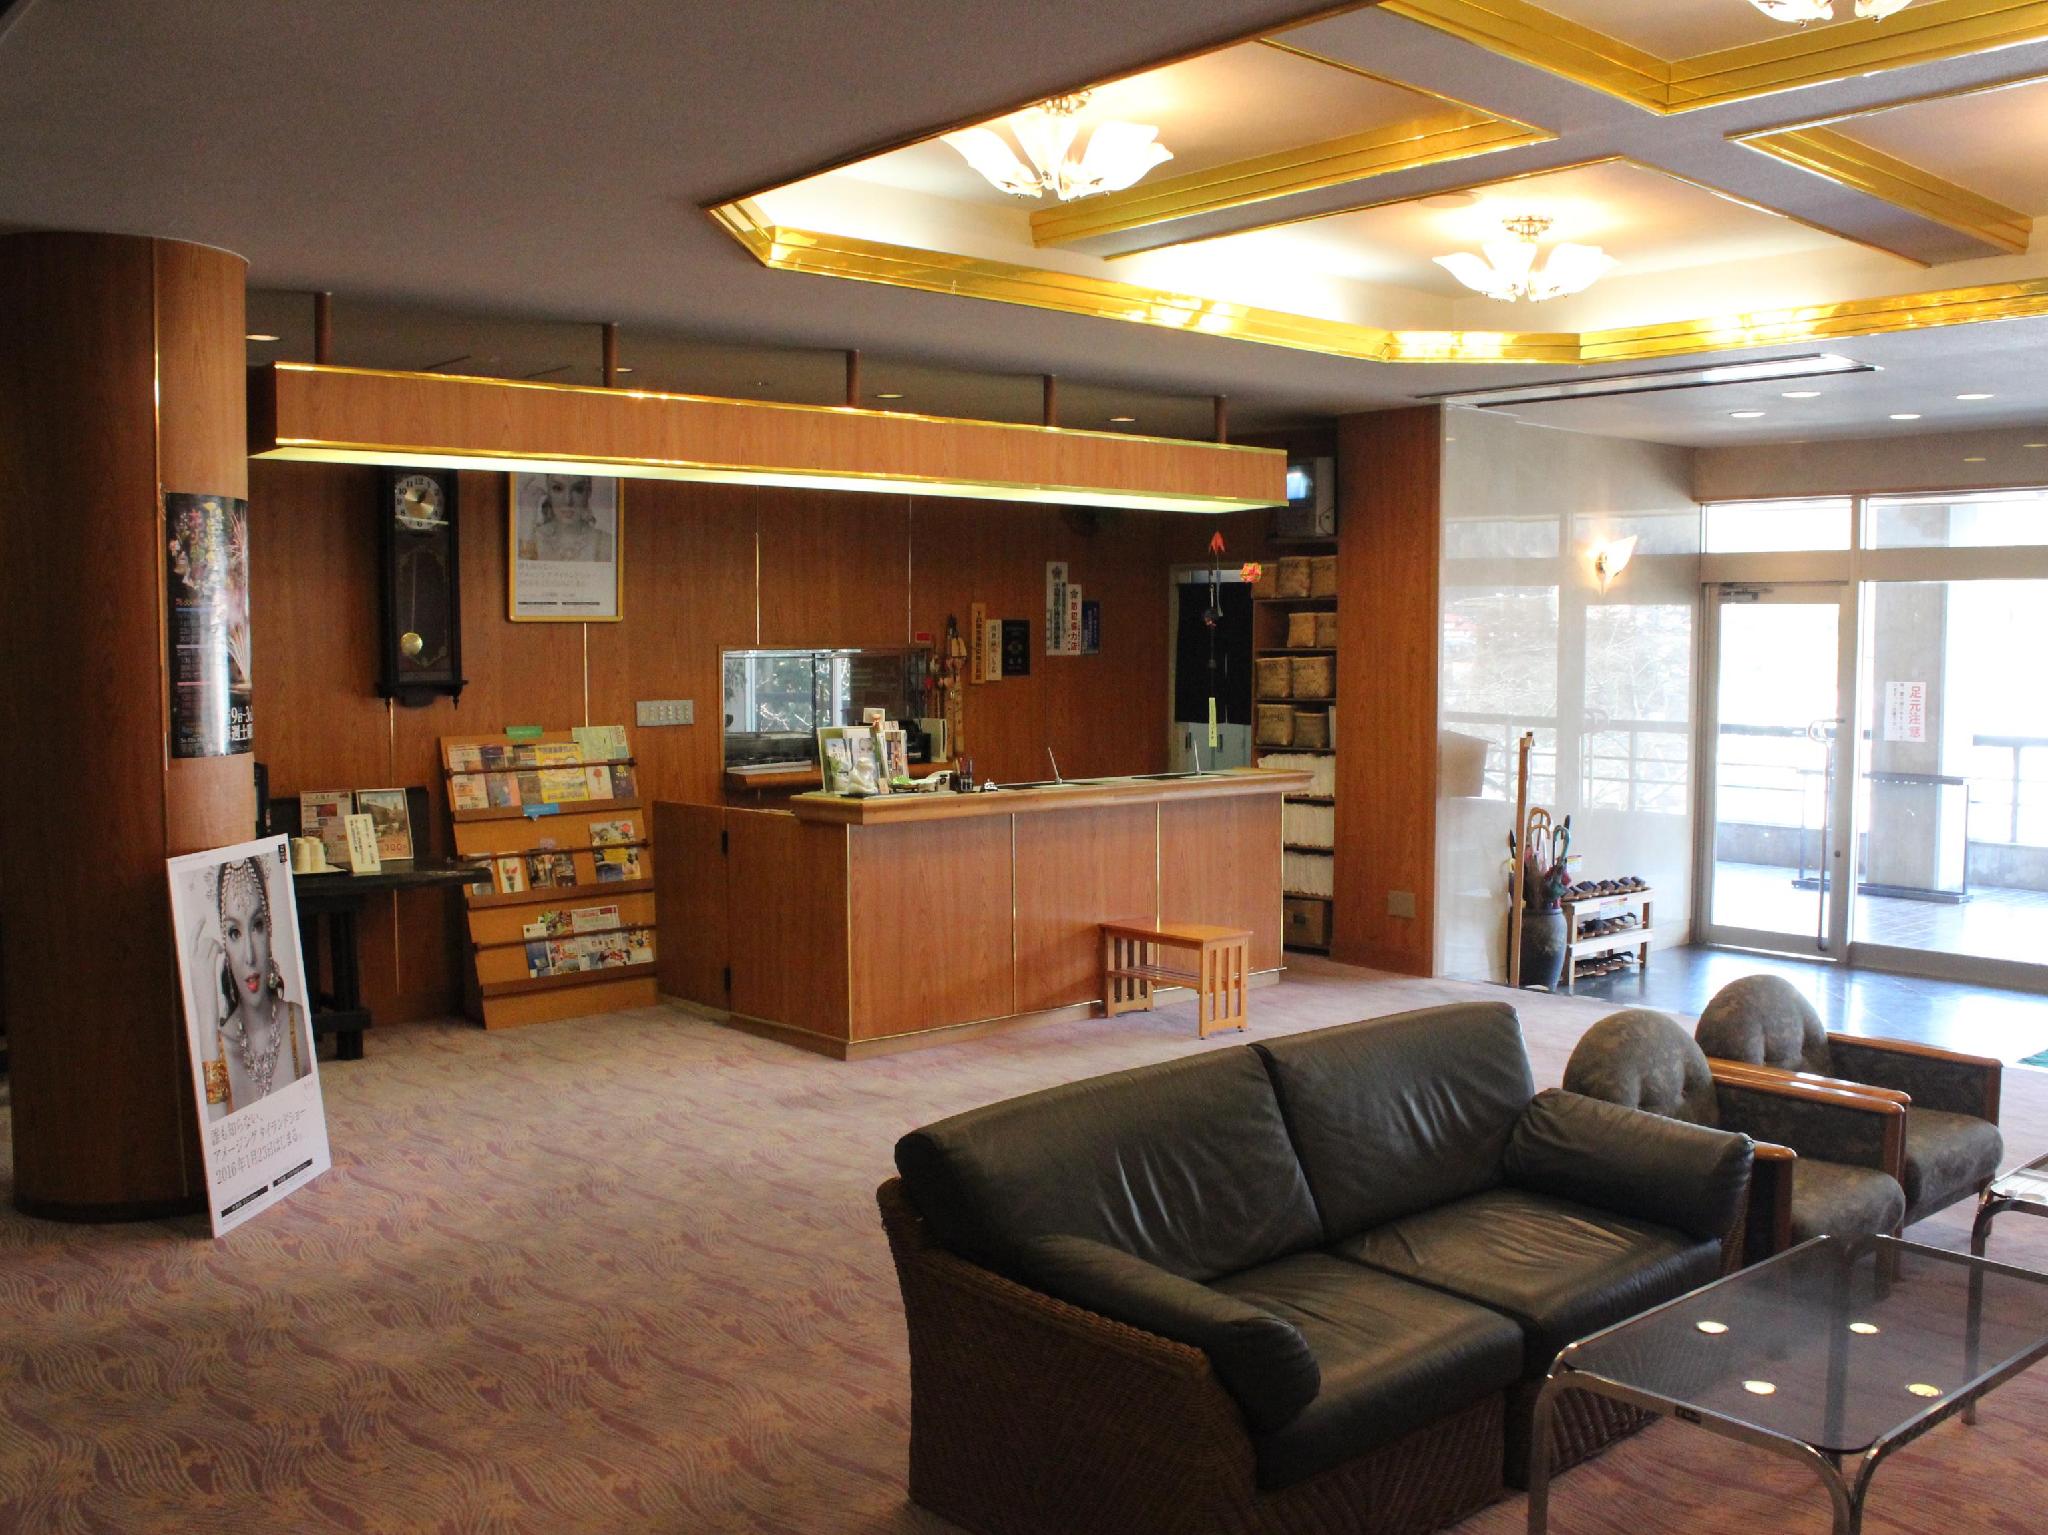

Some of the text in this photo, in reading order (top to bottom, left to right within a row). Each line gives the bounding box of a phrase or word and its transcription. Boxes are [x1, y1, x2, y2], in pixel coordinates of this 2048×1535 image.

[399, 487, 408, 495] 10
[1908, 685, 1922, 738] 足元注意
